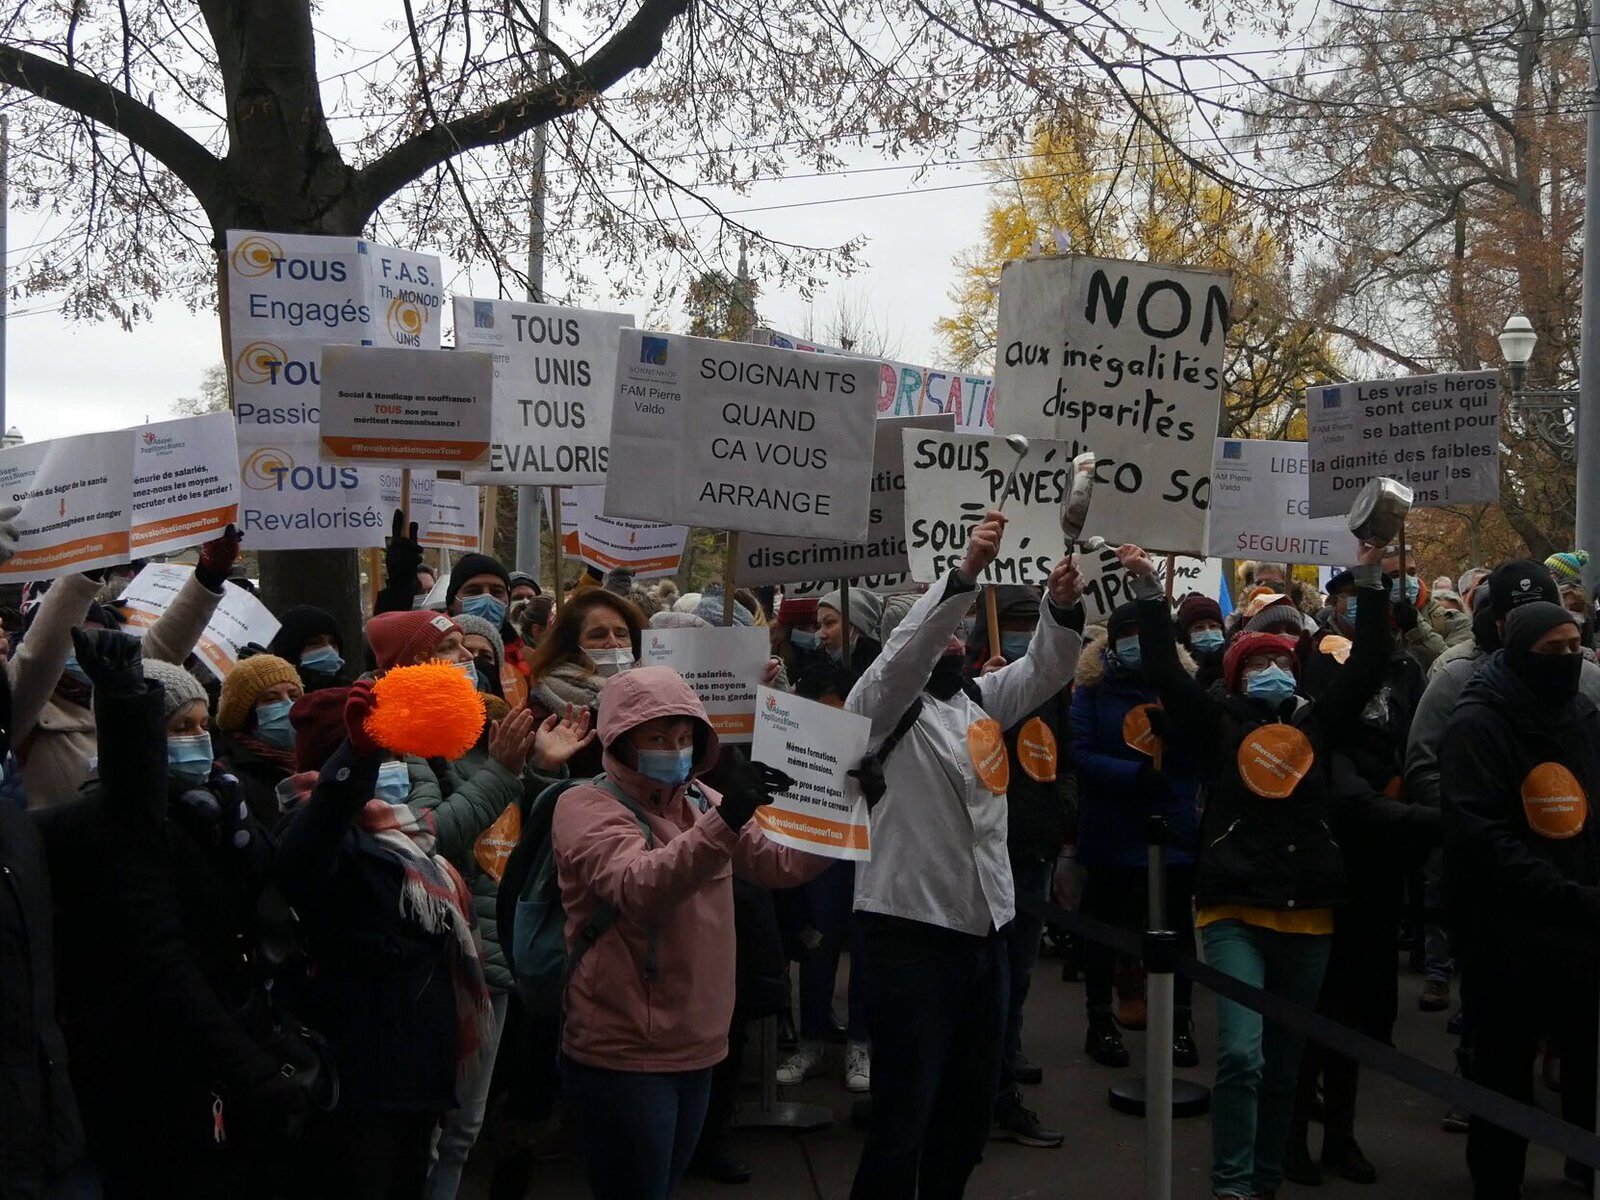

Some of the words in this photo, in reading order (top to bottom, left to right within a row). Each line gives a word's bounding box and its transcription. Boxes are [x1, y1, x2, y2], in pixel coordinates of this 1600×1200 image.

[271, 257, 347, 281] TOUS
[380, 258, 434, 287] F.A.S.
[379, 285, 395, 299] Th.
[399, 289, 439, 308] MONOD
[249, 294, 370, 327] Engagés
[397, 332, 420, 347] UNIS
[512, 314, 580, 347] TOUS
[535, 357, 591, 387] UNIS
[1005, 341, 1049, 367] aux
[1064, 342, 1218, 390] inégalités
[339, 391, 364, 399] Social
[374, 392, 413, 402] Handicap
[427, 395, 472, 404] souffrance
[621, 384, 646, 398] FAM
[649, 387, 682, 401] Pierre
[1358, 387, 1389, 402] Les
[1395, 380, 1437, 397] vrais
[1444, 376, 1497, 392] héros
[374, 404, 402, 414] TOUS
[421, 409, 438, 418] pros
[518, 399, 585, 429] TOUS
[634, 401, 665, 415] Valdo
[723, 402, 815, 432] QUAND
[1042, 377, 1194, 441] disparités
[1365, 401, 1404, 418] sont
[1411, 397, 1453, 413] ceux
[1460, 393, 1487, 411] qui
[354, 416, 389, 425] méritent
[1363, 427, 1383, 439] se
[1389, 419, 1450, 437] battent
[1454, 414, 1498, 431] pour
[712, 438, 747, 462] CA
[756, 441, 827, 469] VOUS
[914, 438, 989, 472] SOUS
[1311, 459, 1325, 473] la
[1330, 449, 1387, 471] dignité
[1394, 448, 1425, 462] des
[1432, 443, 1496, 460] faibles.
[162, 472, 173, 481] de
[174, 481, 187, 490] les
[188, 475, 219, 489] moyens
[270, 466, 358, 491] TOUS
[1445, 464, 1471, 480] les
[45, 487, 54, 496] du
[87, 476, 107, 486] santé
[167, 495, 176, 503] et
[177, 493, 188, 502] de
[189, 491, 202, 500] les
[203, 485, 228, 499] garder
[699, 481, 830, 516] ARRANGE
[86, 513, 95, 522] en
[96, 510, 122, 521] danger
[244, 505, 384, 531] Revalorisés
[685, 671, 695, 679] de
[697, 670, 736, 679] salariés,
[696, 681, 709, 690] les
[711, 682, 746, 691] moyens
